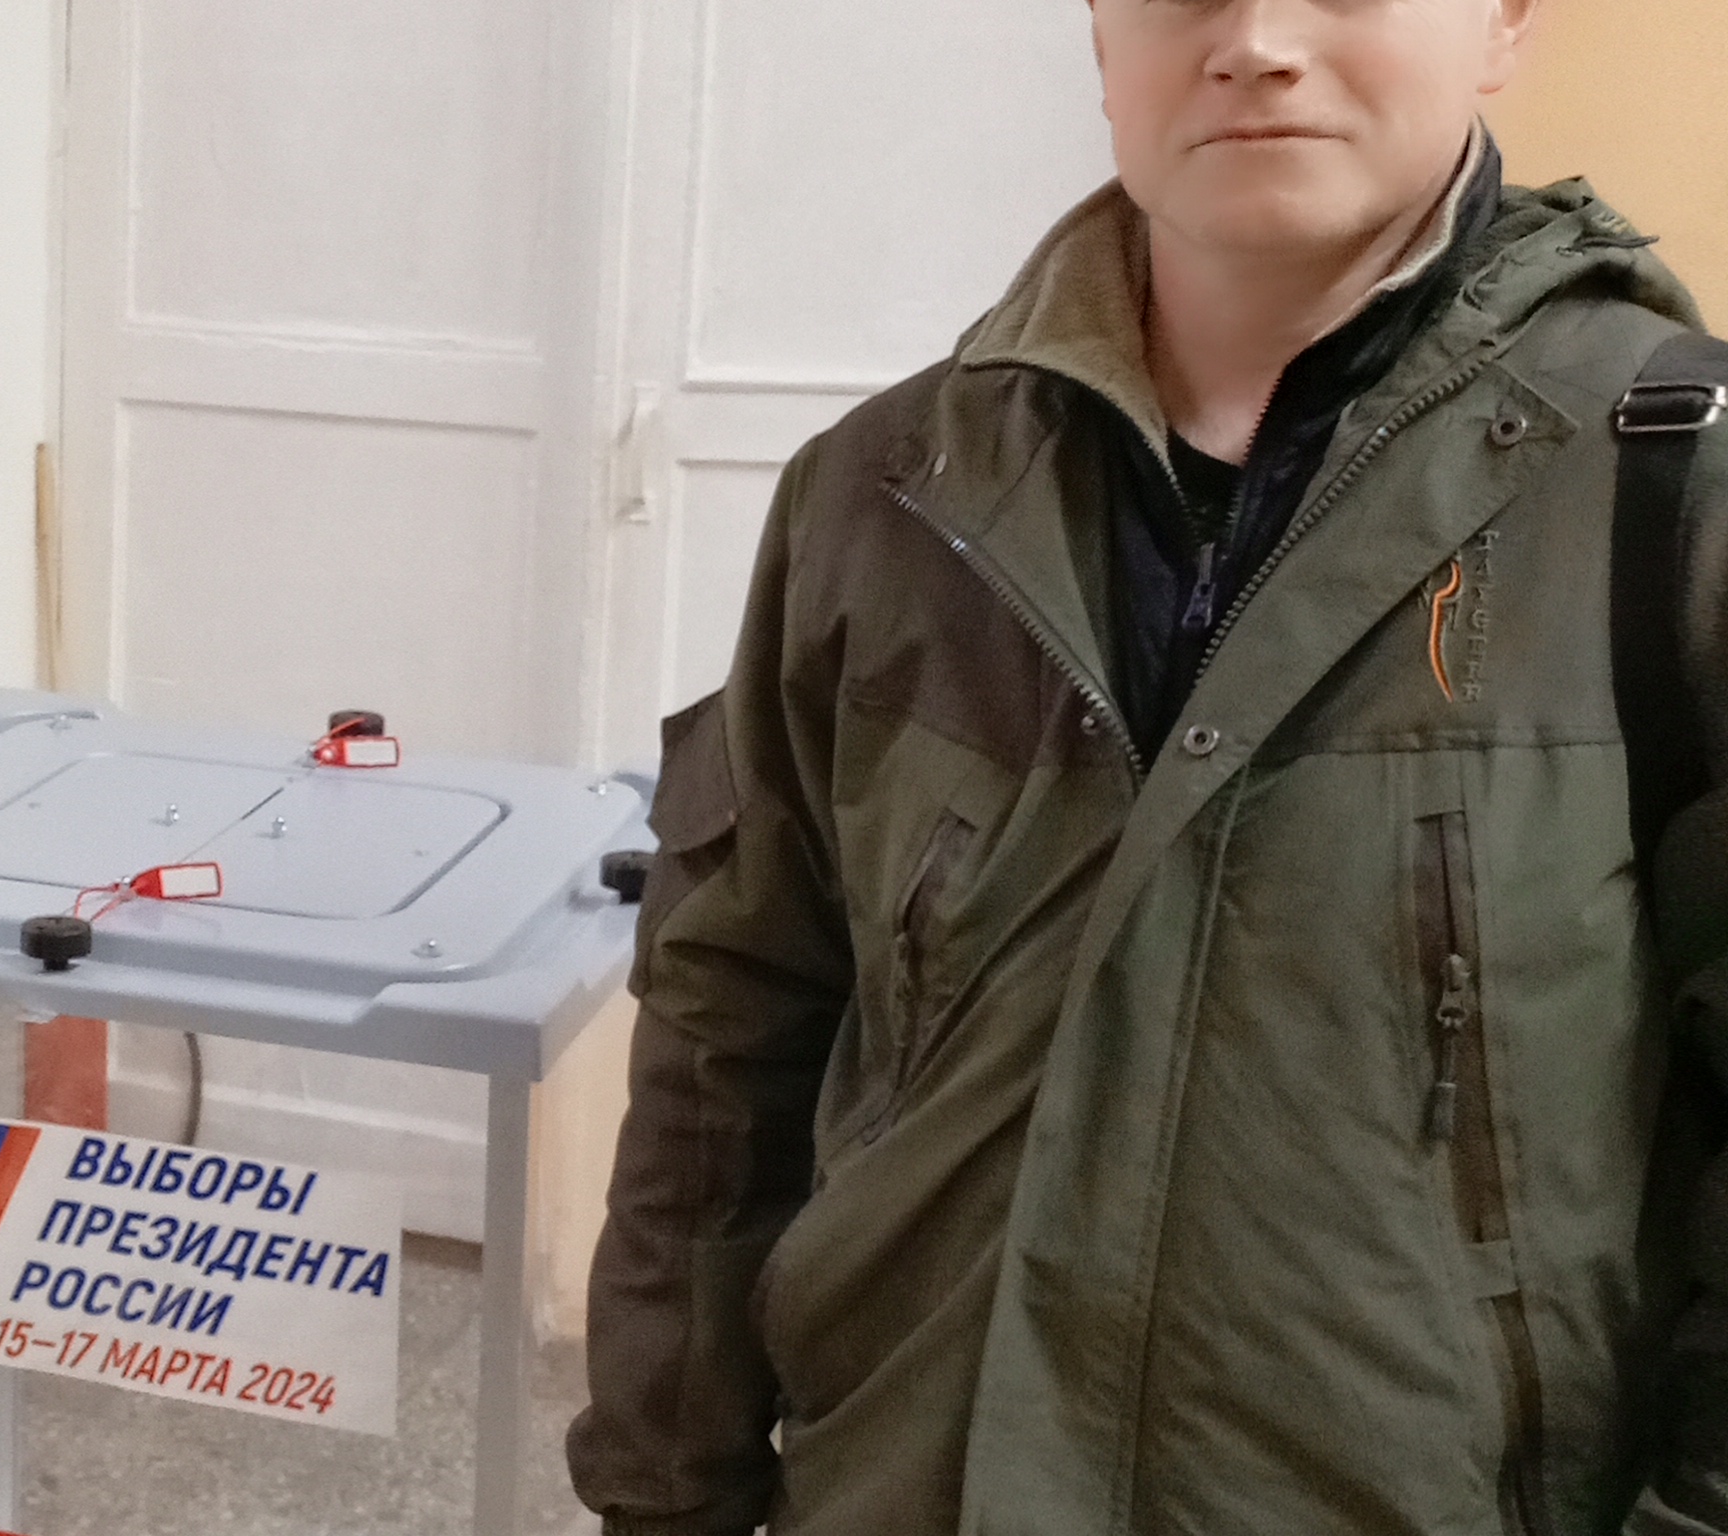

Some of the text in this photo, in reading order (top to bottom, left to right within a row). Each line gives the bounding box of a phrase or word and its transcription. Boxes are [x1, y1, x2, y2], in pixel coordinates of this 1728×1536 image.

[66, 1137, 318, 1216] ВЫБОРЫ
[38, 1199, 393, 1298] ПРЕЗИДЕНТА
[10, 1260, 234, 1337] РОССИИ
[101, 1341, 230, 1398] МАРТА
[235, 1362, 337, 1415] 2024
